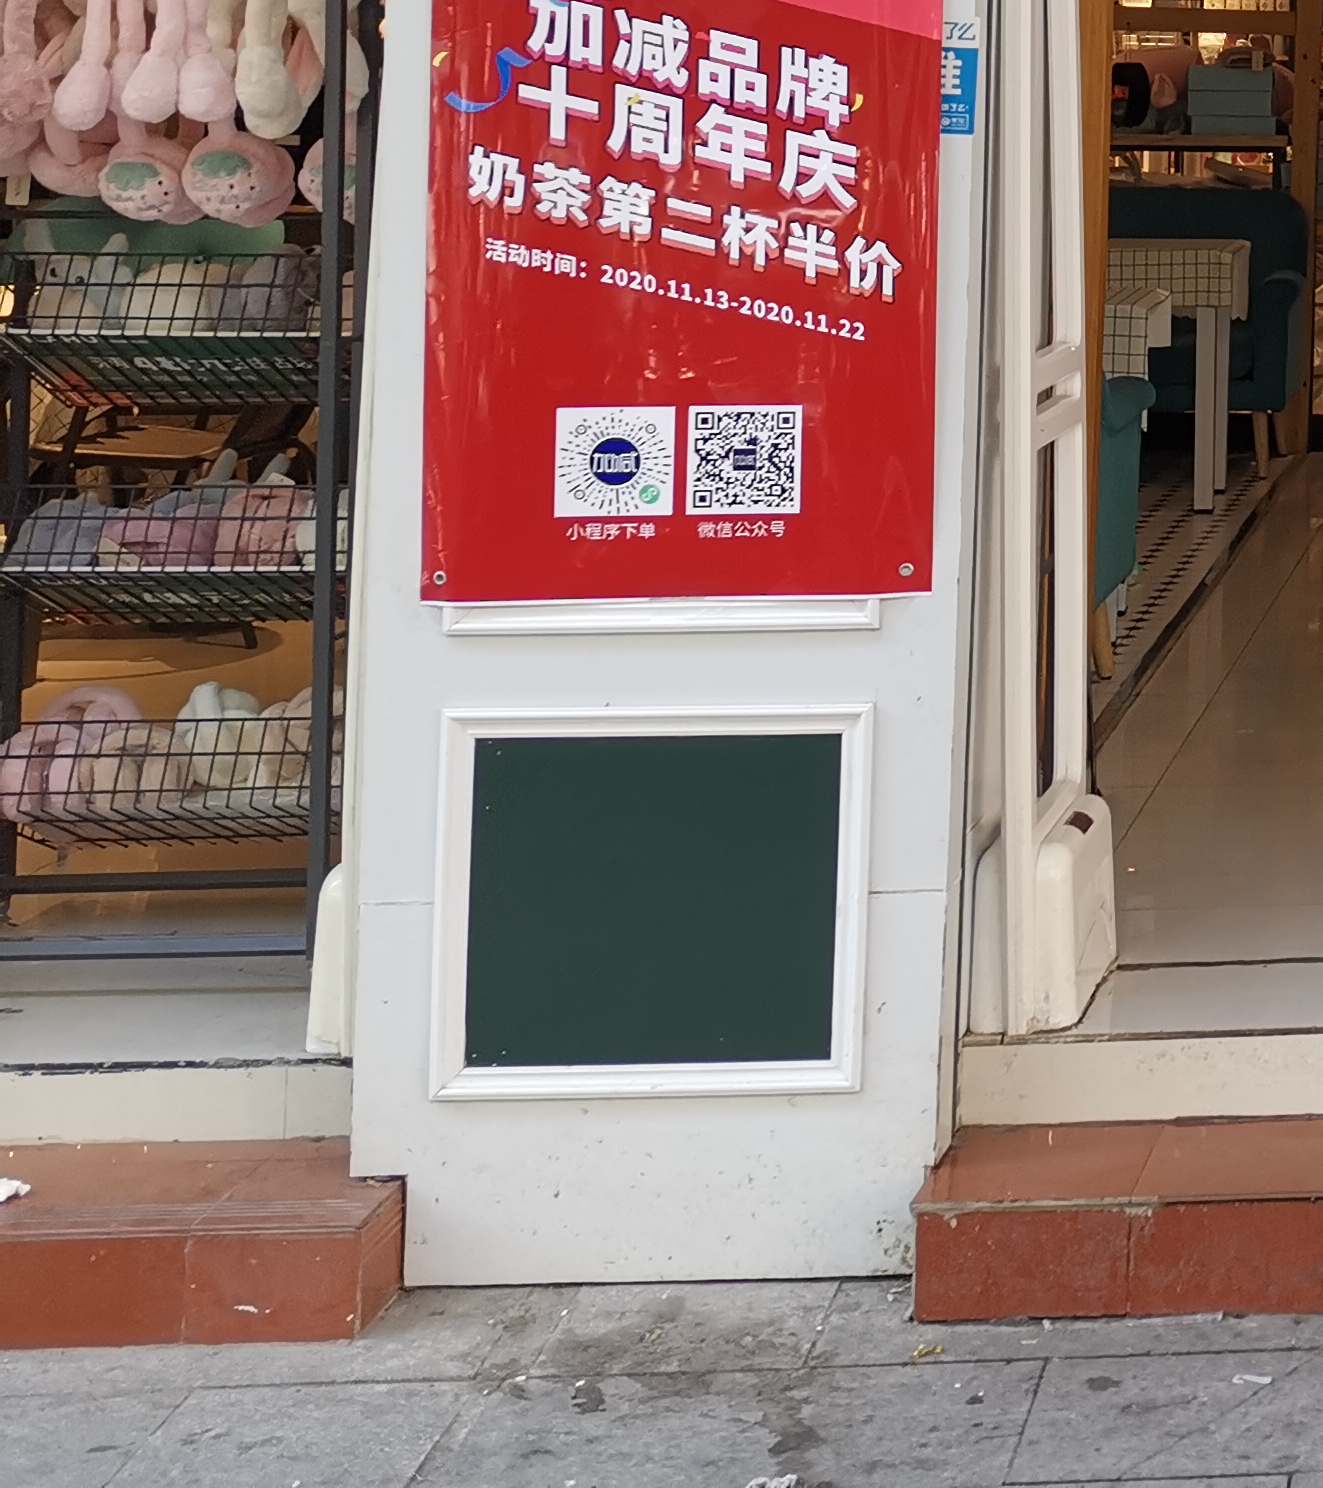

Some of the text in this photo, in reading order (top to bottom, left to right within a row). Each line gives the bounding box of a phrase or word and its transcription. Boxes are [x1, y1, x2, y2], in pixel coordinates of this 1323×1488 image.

[517, 65, 859, 213] 十周年庆
[466, 145, 904, 303] 奶茶第二杯半价
[592, 450, 638, 473] 加减
[565, 522, 656, 541] 小程序下单
[697, 520, 786, 539] 微信公众号
